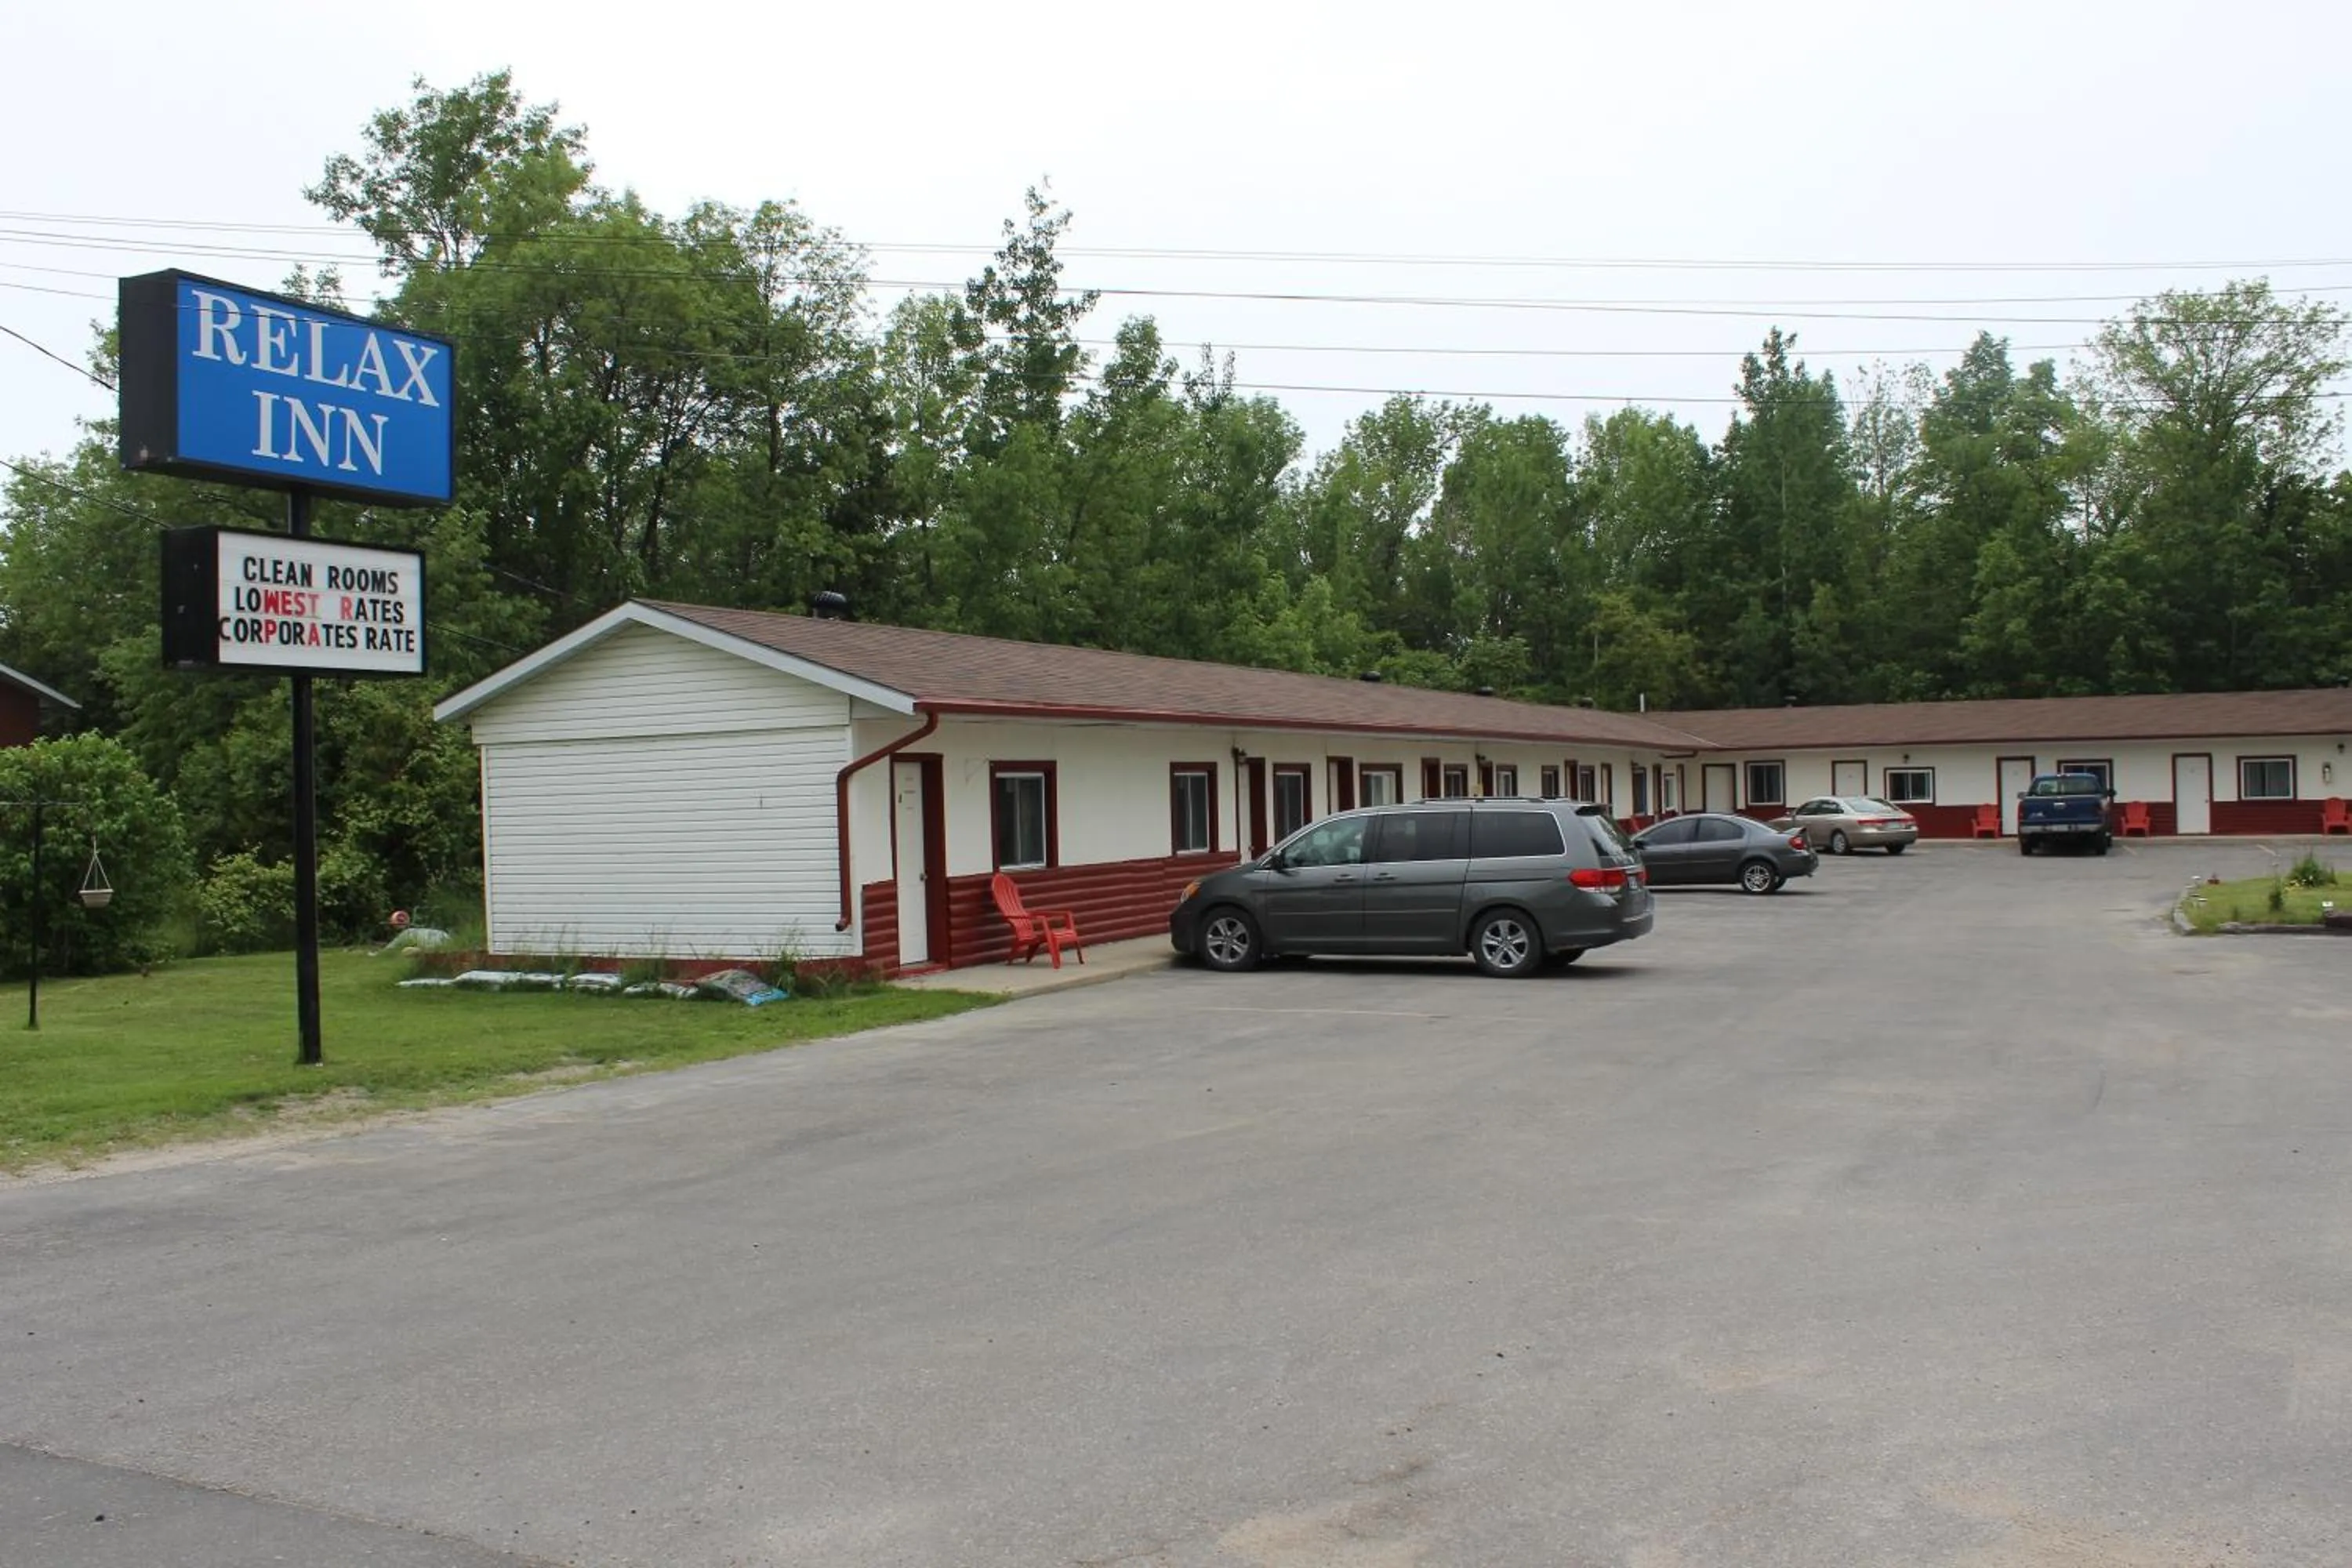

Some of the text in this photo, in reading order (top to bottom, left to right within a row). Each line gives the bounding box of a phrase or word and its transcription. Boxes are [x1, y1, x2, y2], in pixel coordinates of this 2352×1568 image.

[191, 289, 440, 408] RELAX
[251, 390, 389, 476] INN
[243, 556, 399, 595] CLEAN ROOMS
[235, 586, 405, 624] LOWEST RATES
[220, 617, 415, 653] CORPORATES RATE
